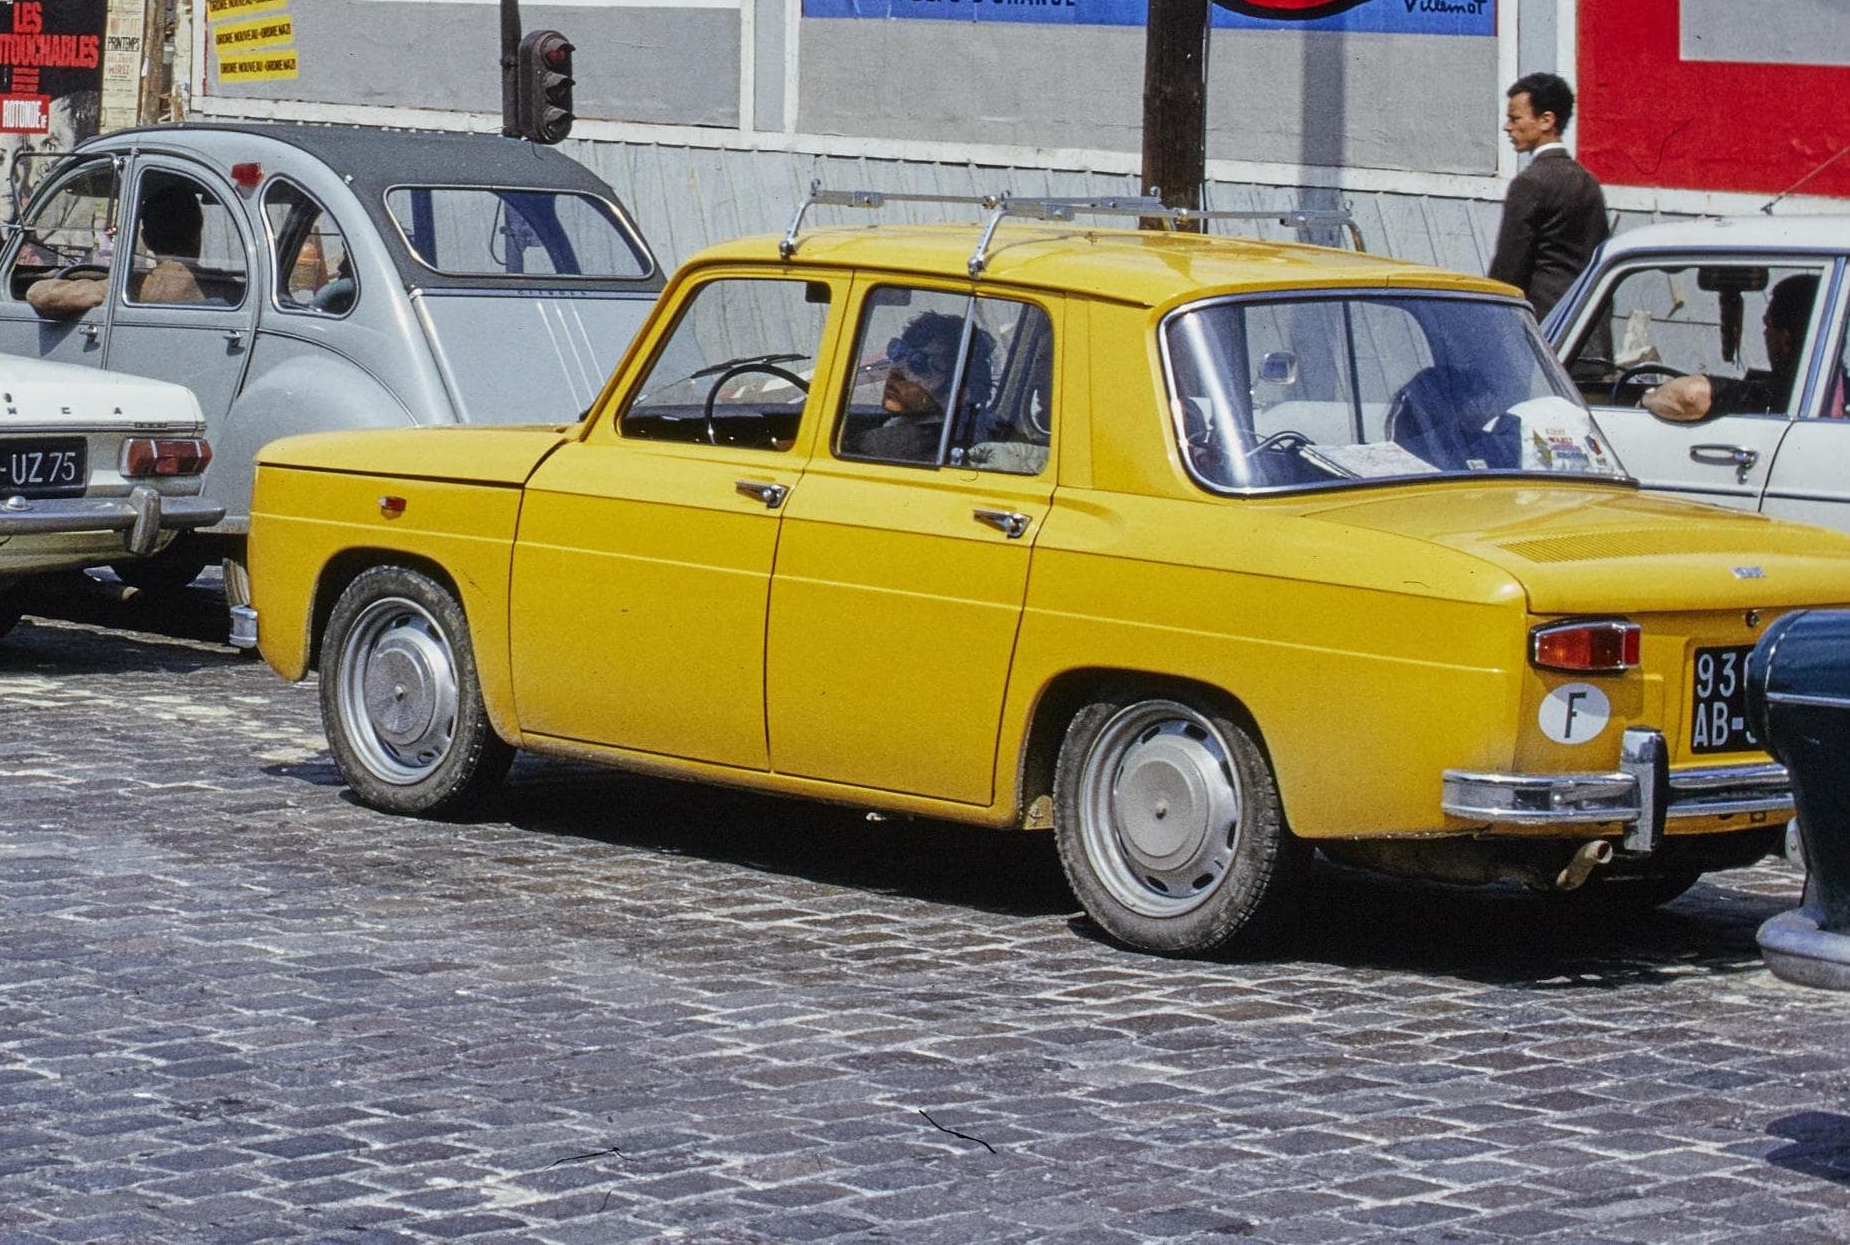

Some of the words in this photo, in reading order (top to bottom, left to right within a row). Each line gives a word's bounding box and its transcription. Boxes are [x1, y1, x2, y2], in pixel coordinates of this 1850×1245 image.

[13, 1, 42, 33] LES
[1696, 651, 1754, 698] 93
[1563, 690, 1588, 739] F
[1692, 700, 1757, 747] AB-
